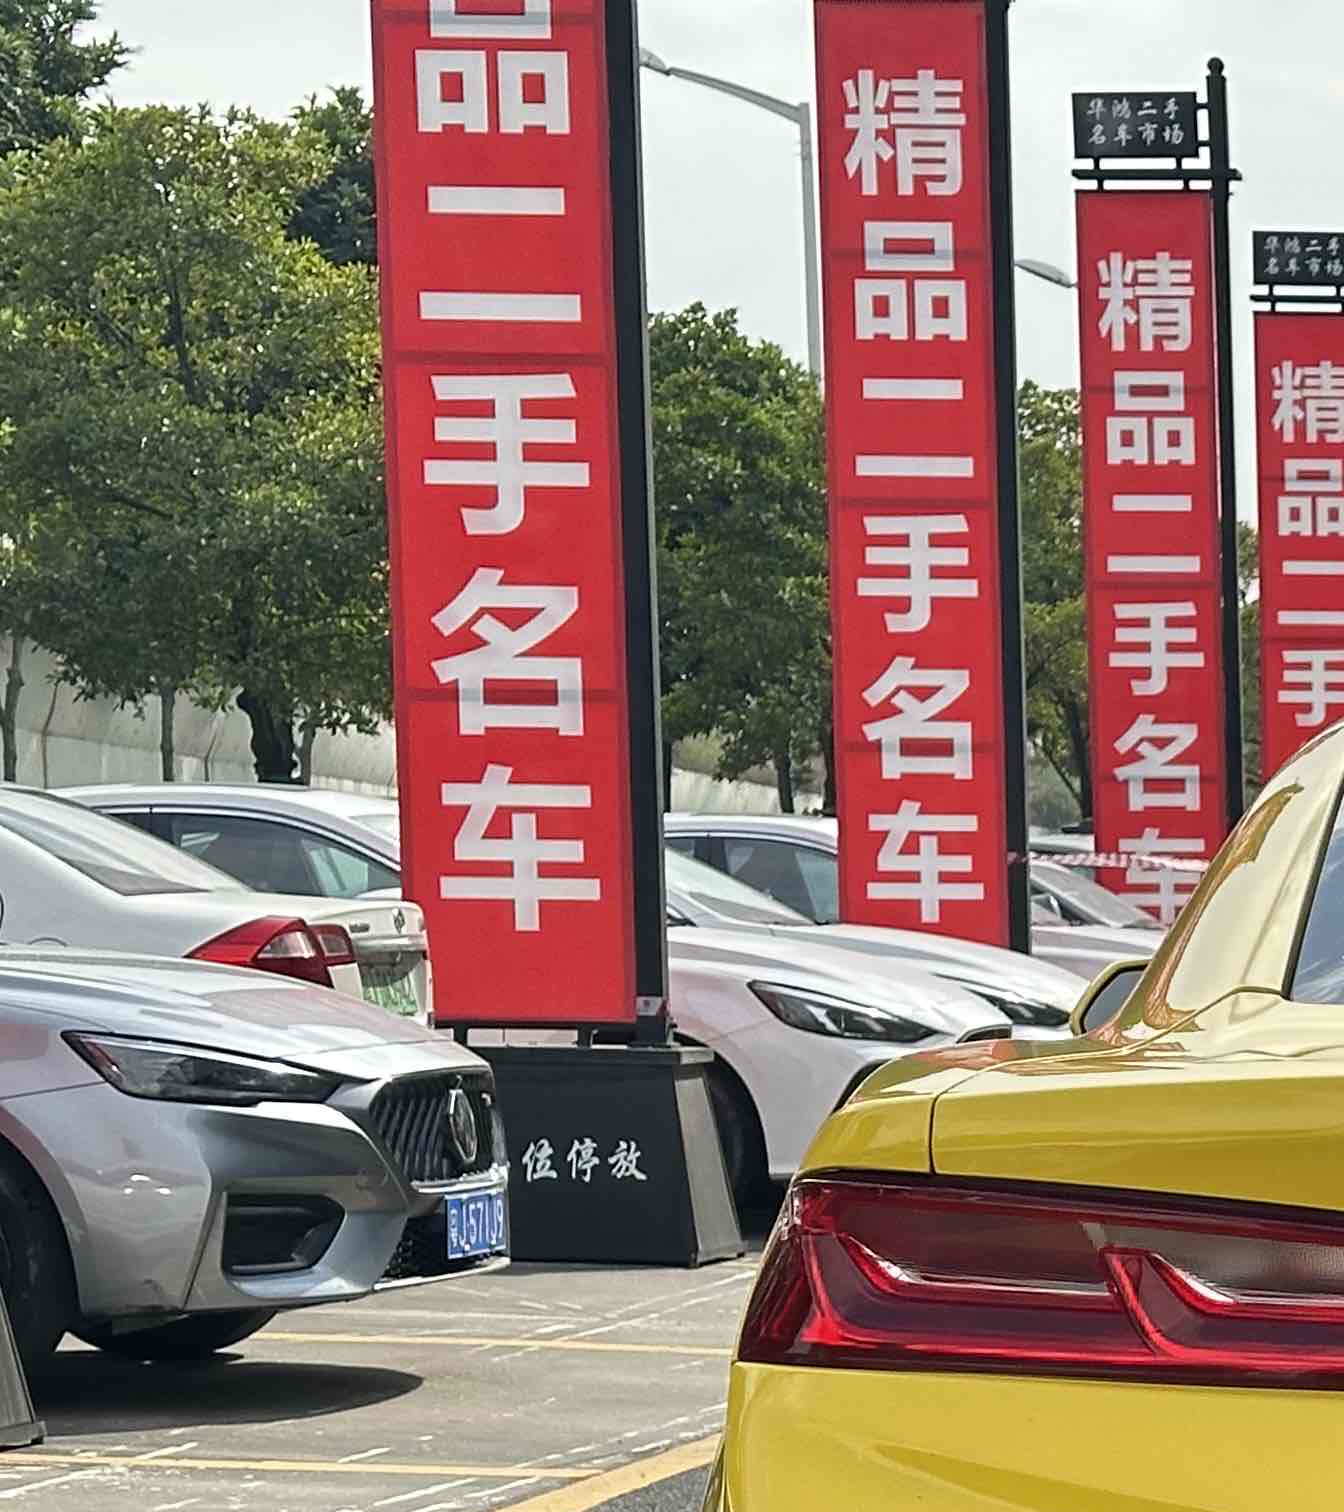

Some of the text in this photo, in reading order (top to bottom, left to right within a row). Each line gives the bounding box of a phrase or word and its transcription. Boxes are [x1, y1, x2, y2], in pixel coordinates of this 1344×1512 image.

[1086, 96, 1180, 120] 华鸿二手
[1087, 122, 1184, 147] 名车市场
[841, 68, 986, 924] 精品二手名车
[522, 1137, 648, 1183] 位停放
